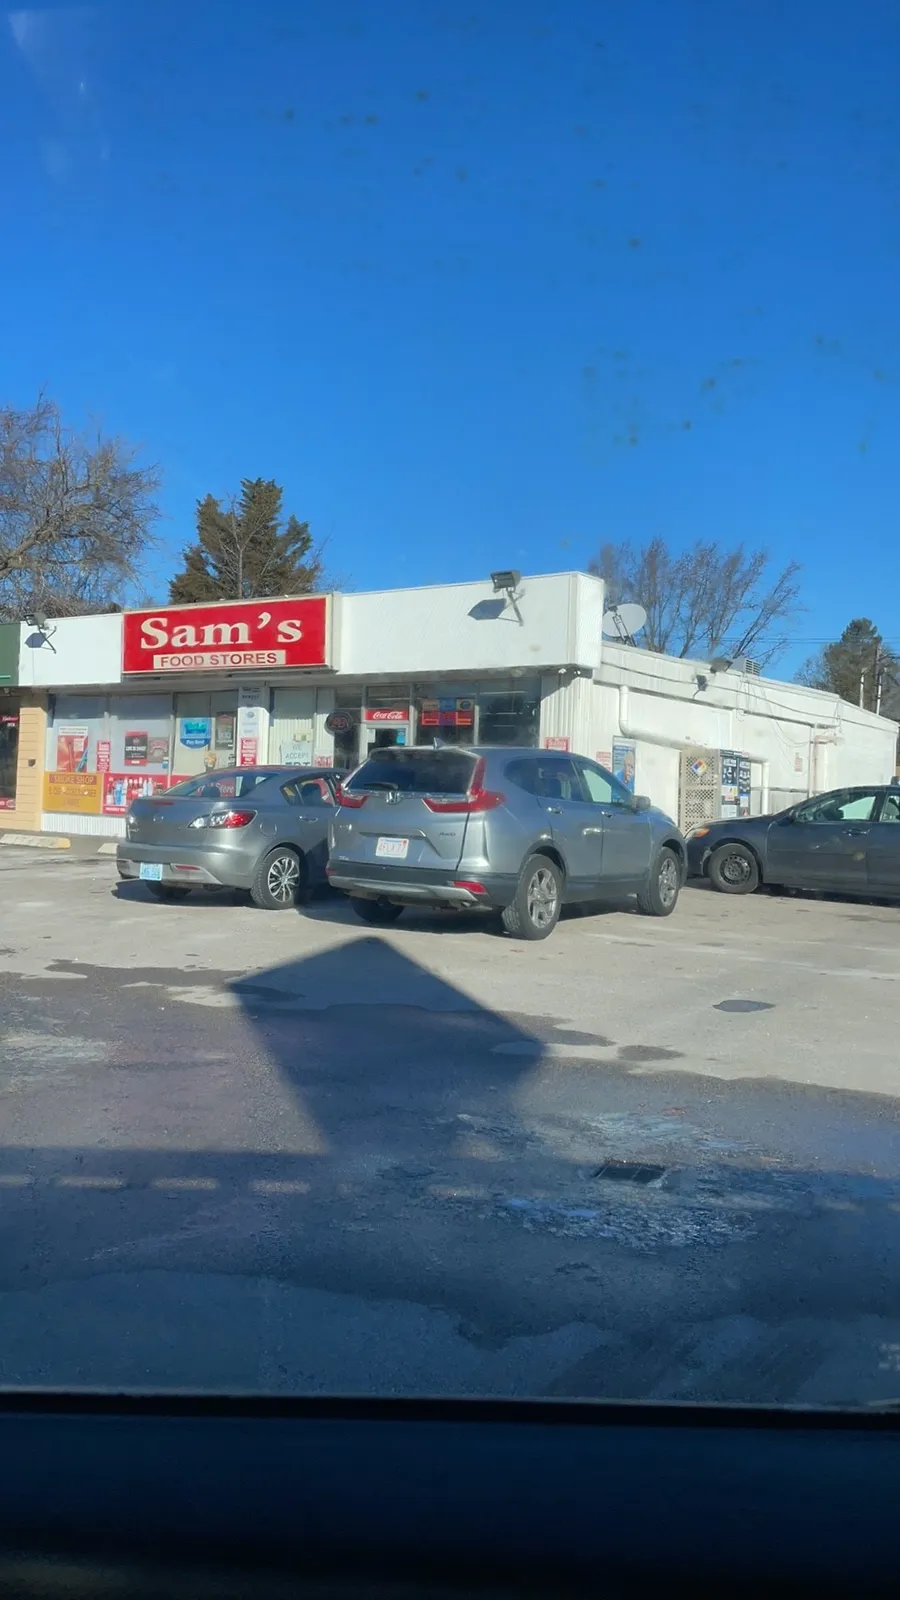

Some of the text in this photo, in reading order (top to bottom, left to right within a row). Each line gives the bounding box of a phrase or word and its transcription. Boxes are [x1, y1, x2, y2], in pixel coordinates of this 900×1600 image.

[141, 612, 303, 649] Sam's
[160, 652, 277, 667] FOOD STORES
[372, 711, 405, 720] Coca-Cola
[75, 775, 94, 785] SHOP
